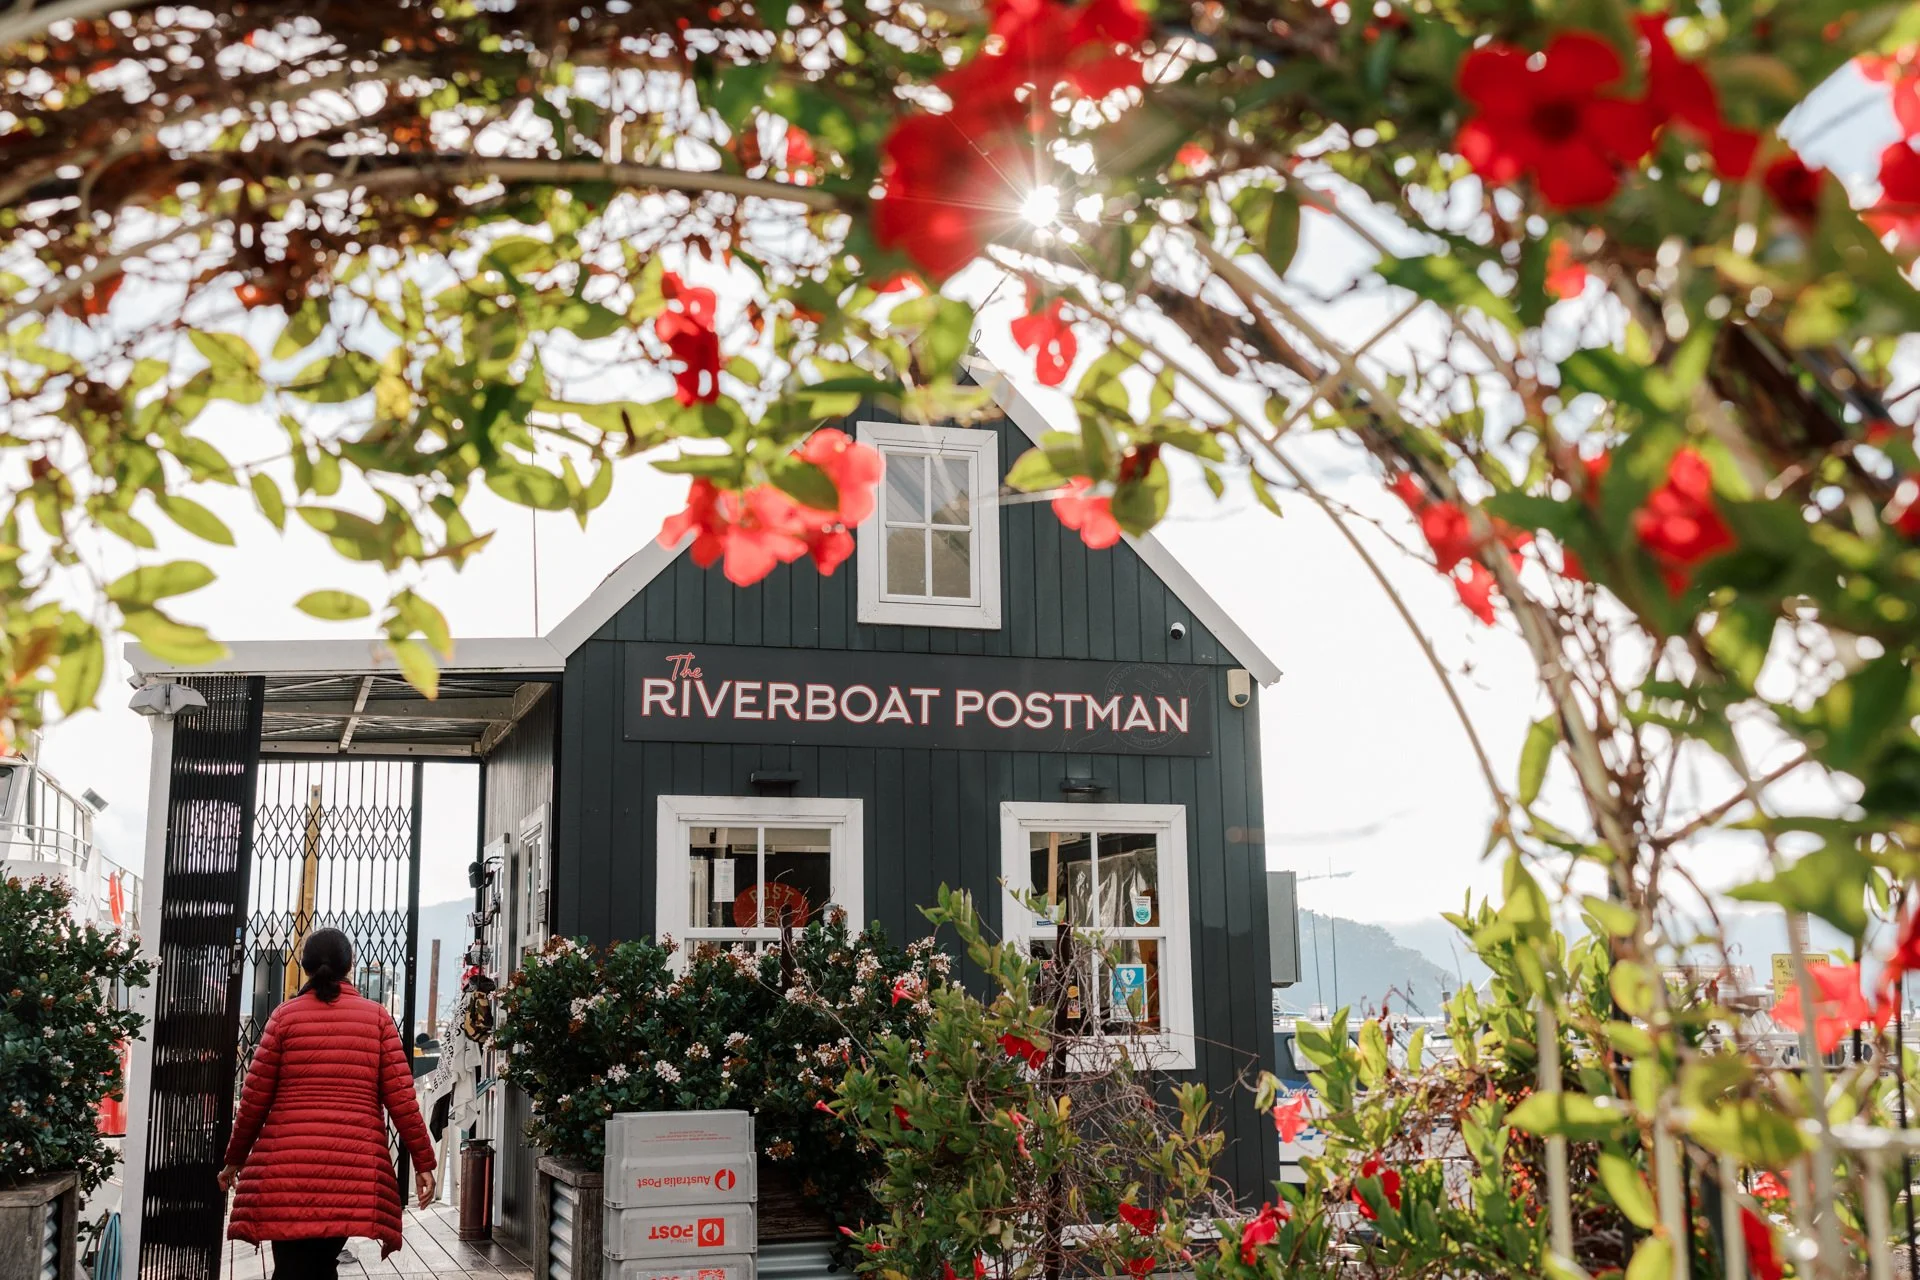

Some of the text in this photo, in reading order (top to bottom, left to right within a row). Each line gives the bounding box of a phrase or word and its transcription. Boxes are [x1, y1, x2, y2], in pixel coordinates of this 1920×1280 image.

[666, 652, 703, 682] The
[641, 677, 1189, 733] RIVERBOAT POSTMAN
[749, 886, 795, 904] POST
[637, 1175, 711, 1189] Australia Post
[648, 1224, 693, 1239] POST
